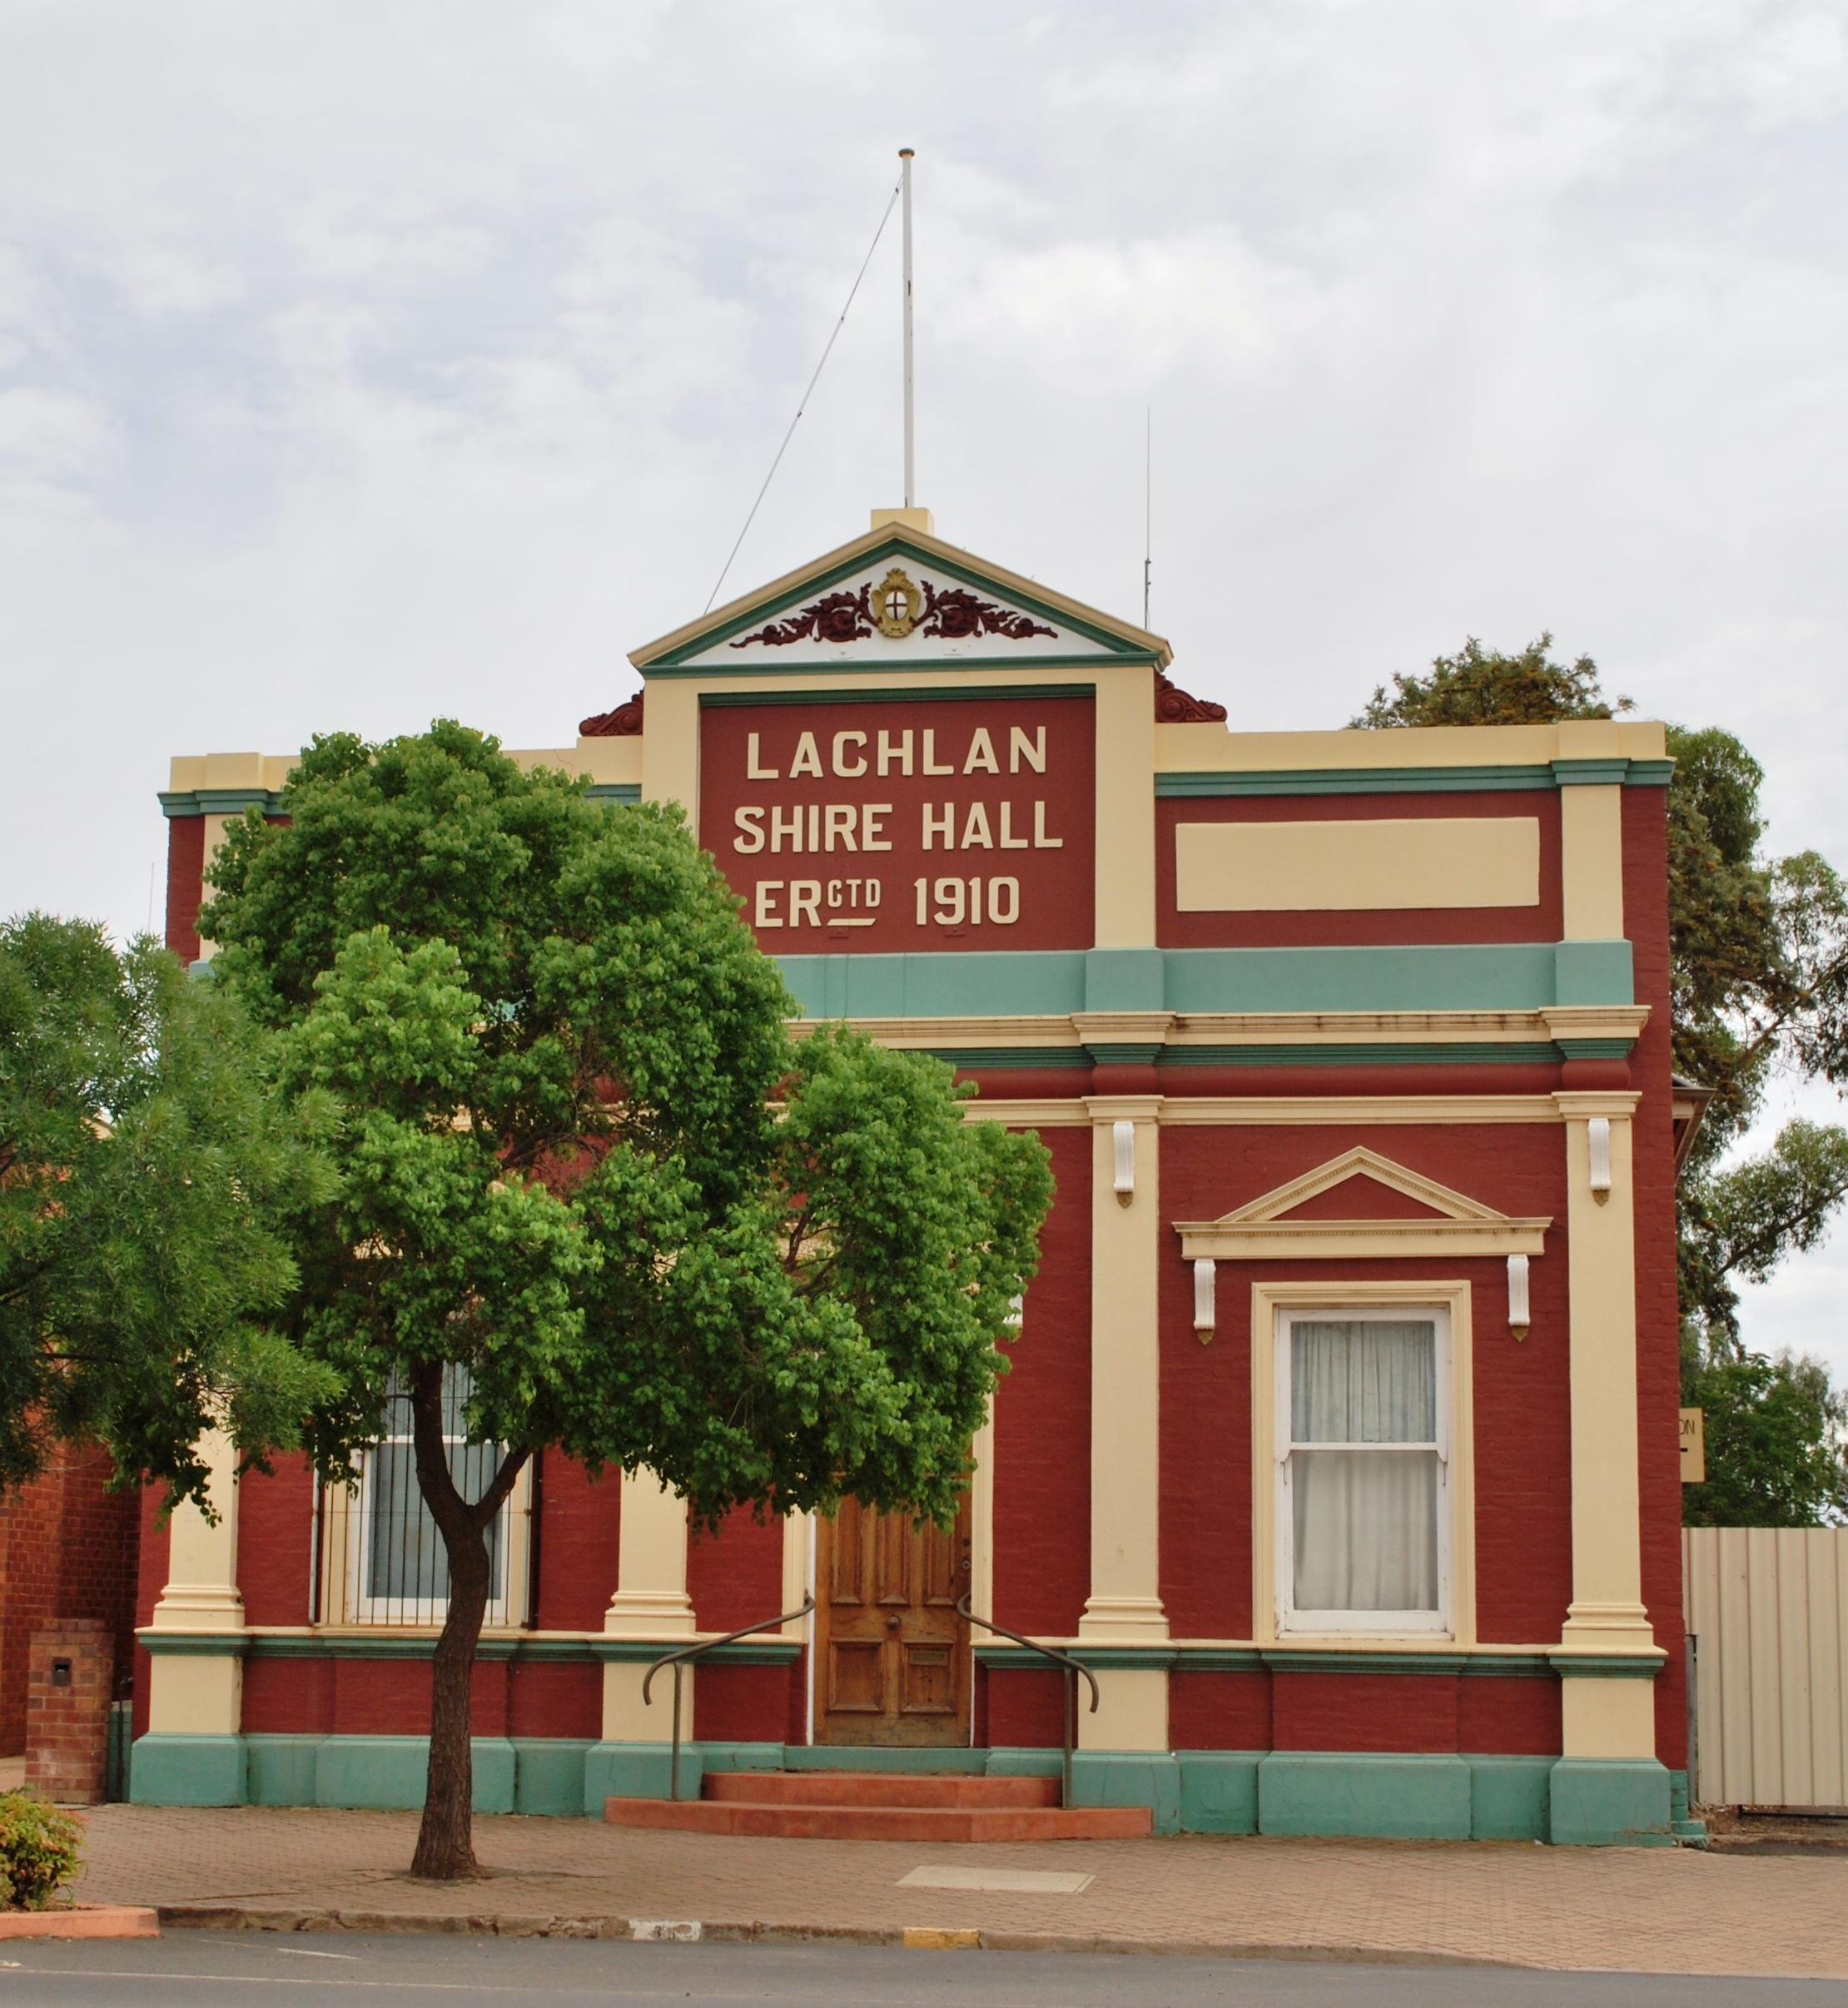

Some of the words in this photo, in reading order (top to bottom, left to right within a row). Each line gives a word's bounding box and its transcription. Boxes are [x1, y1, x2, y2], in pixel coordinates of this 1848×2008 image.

[747, 726, 1046, 779] LACHLAN
[733, 803, 893, 854] SHIRE
[922, 800, 1064, 851] HALL
[913, 876, 1021, 926] 1910
